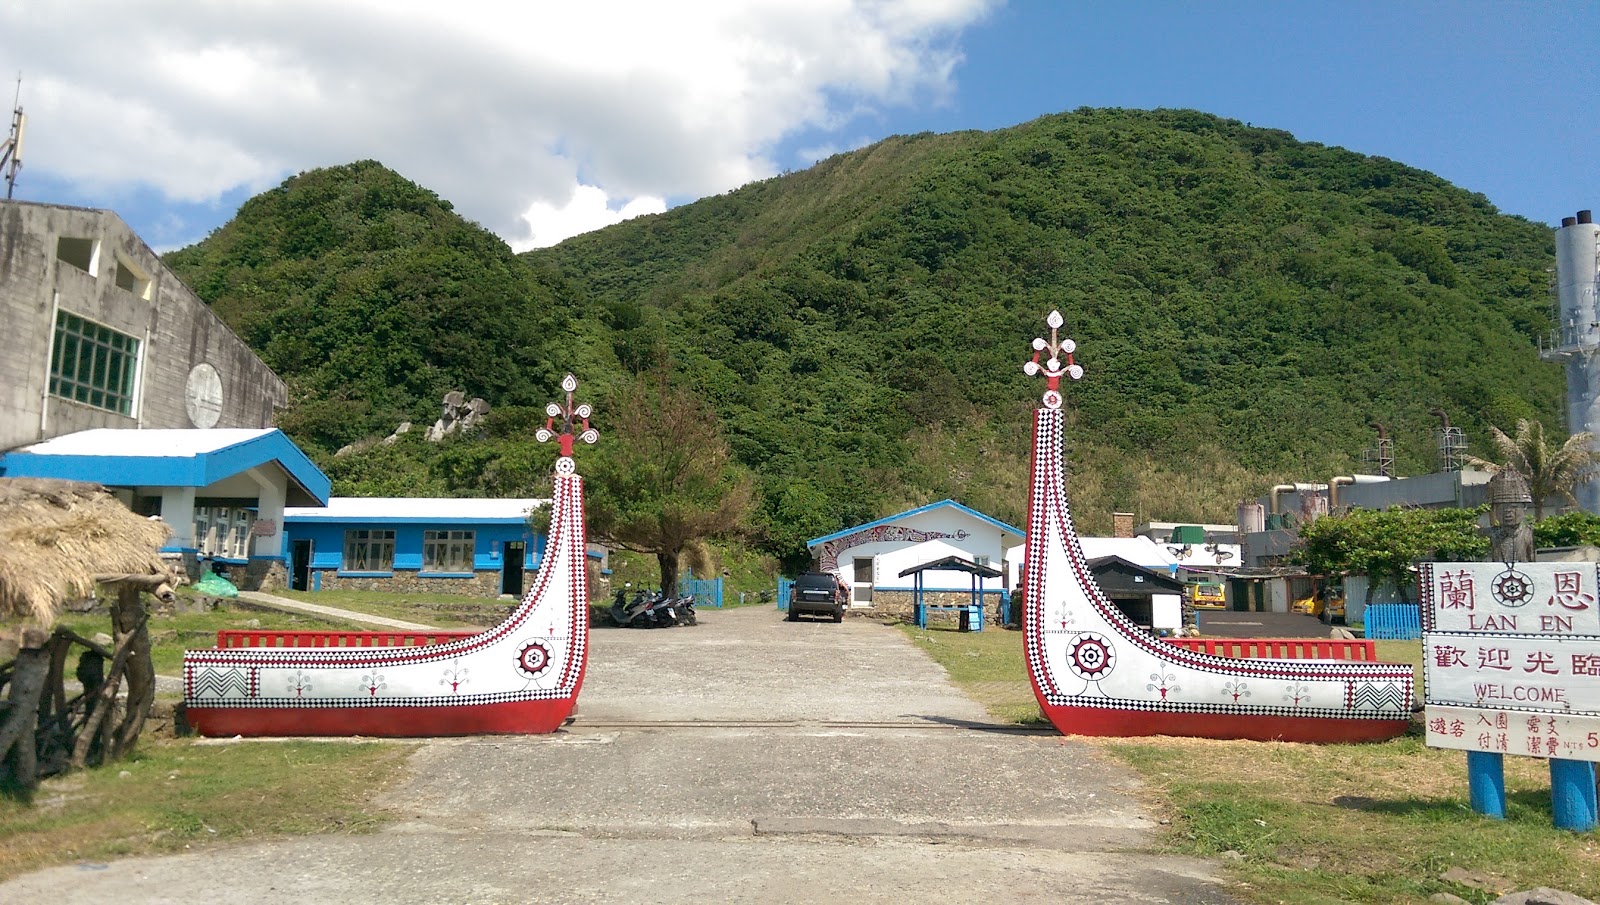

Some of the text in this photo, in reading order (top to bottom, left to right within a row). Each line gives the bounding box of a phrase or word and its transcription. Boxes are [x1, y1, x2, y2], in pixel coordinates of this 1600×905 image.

[1439, 569, 1595, 611] 蘭 恩
[1468, 614, 1573, 632] LAN EN
[1473, 682, 1566, 703] WELCOME
